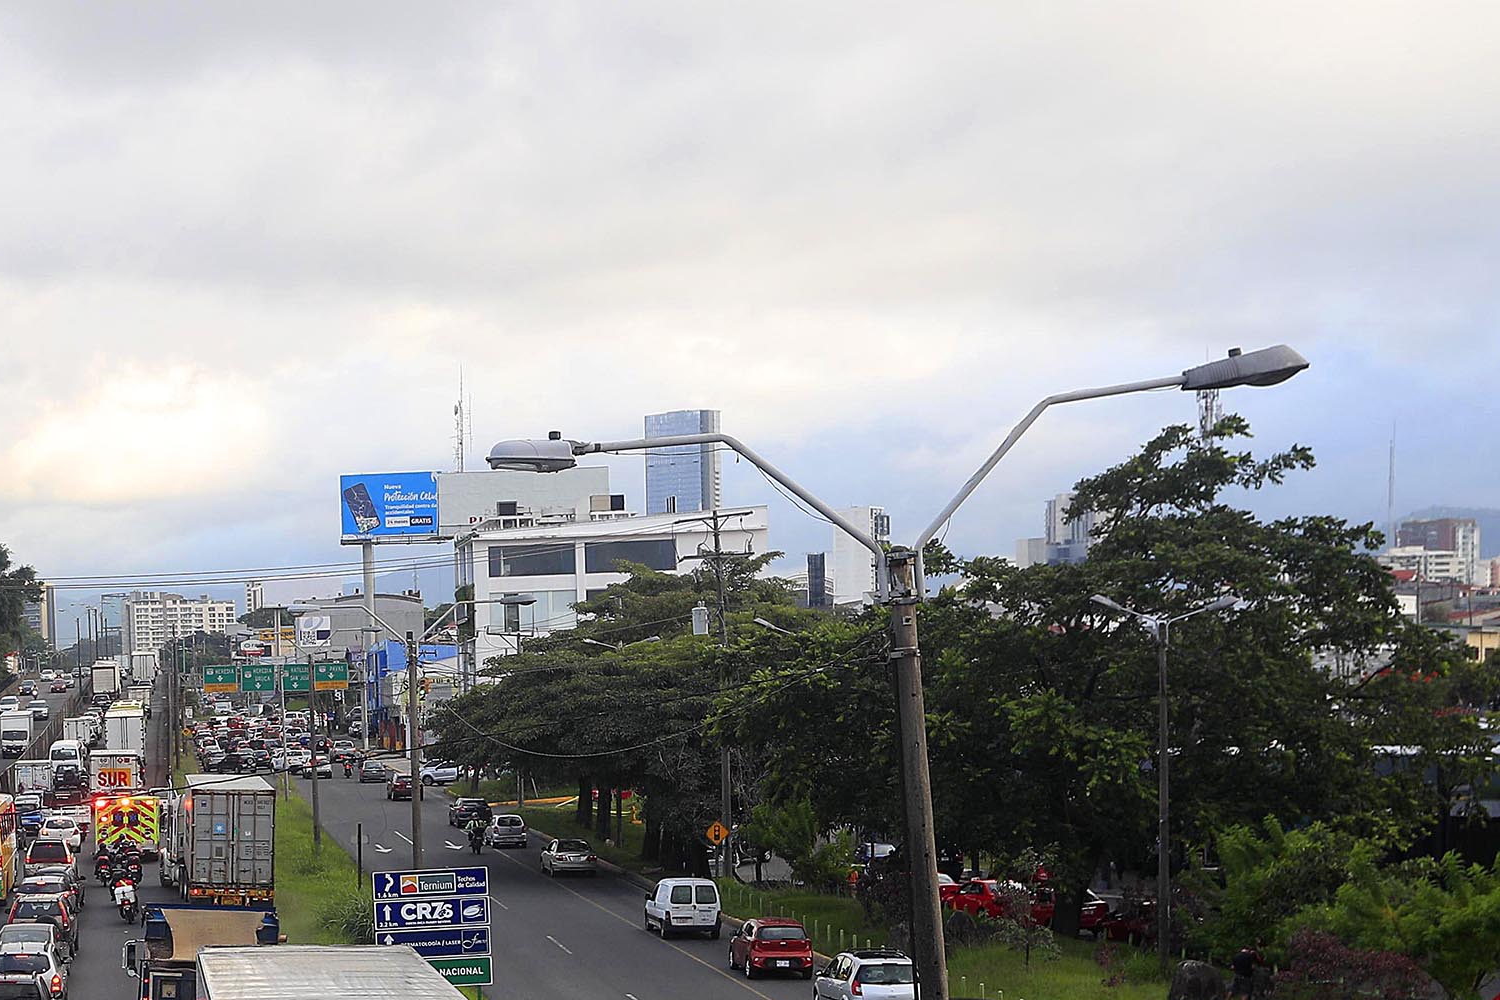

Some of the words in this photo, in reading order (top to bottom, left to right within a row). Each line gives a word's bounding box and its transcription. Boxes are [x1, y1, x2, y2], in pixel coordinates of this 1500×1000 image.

[98, 772, 127, 786] SUR
[420, 881, 453, 891] Ternium
[440, 967, 484, 976] NACIONAL
